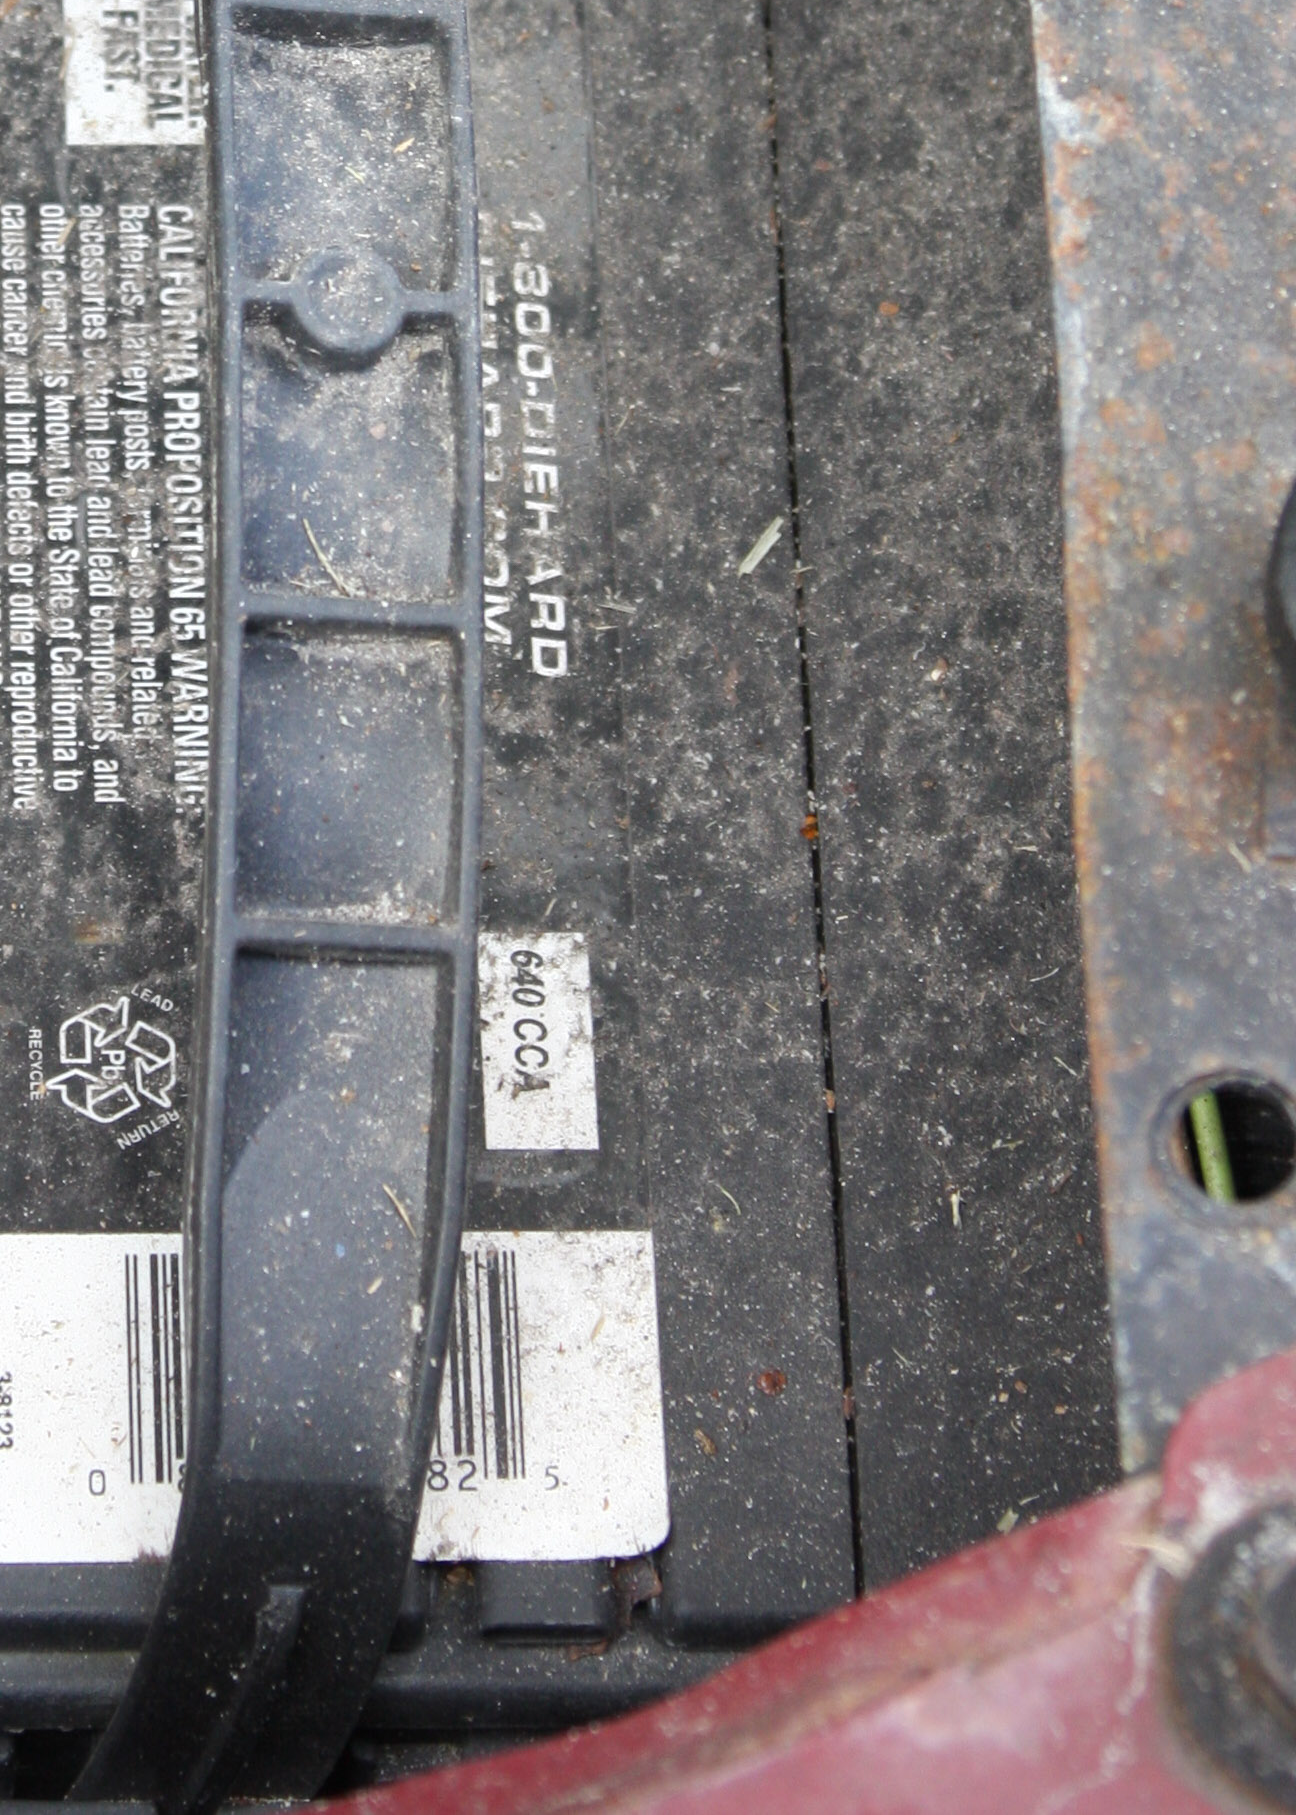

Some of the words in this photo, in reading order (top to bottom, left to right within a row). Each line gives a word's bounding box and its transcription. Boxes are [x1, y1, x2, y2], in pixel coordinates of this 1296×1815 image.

[102, 9, 143, 93] FAST.
[0, 204, 27, 272] cause
[39, 204, 68, 265] other
[79, 204, 112, 341] accessories
[158, 204, 200, 384] CALIFORNIA
[1, 278, 30, 357] cancer
[4, 412, 38, 465] birth
[44, 394, 77, 470] known
[5, 471, 40, 556] defects
[46, 477, 78, 498] to
[86, 496, 119, 538] and
[162, 390, 206, 599] PROPOSITION
[47, 505, 79, 542] the
[8, 563, 34, 587] or
[48, 548, 82, 611] State
[87, 547, 120, 598] lead
[9, 594, 43, 656] other
[50, 617, 83, 640] of
[169, 607, 206, 641] 65
[49, 646, 85, 763] California
[4, 662, 45, 811] reproductive
[52, 769, 84, 792] to
[92, 759, 126, 804] and
[129, 985, 175, 1014] LEAD
[510, 949, 546, 1008] 640
[27, 1028, 44, 1102] RECYCLE
[99, 1050, 126, 1081] Pb
[513, 1018, 550, 1095] CCA
[115, 1108, 181, 1151] RETURN
[544, 1465, 560, 1491] 5
